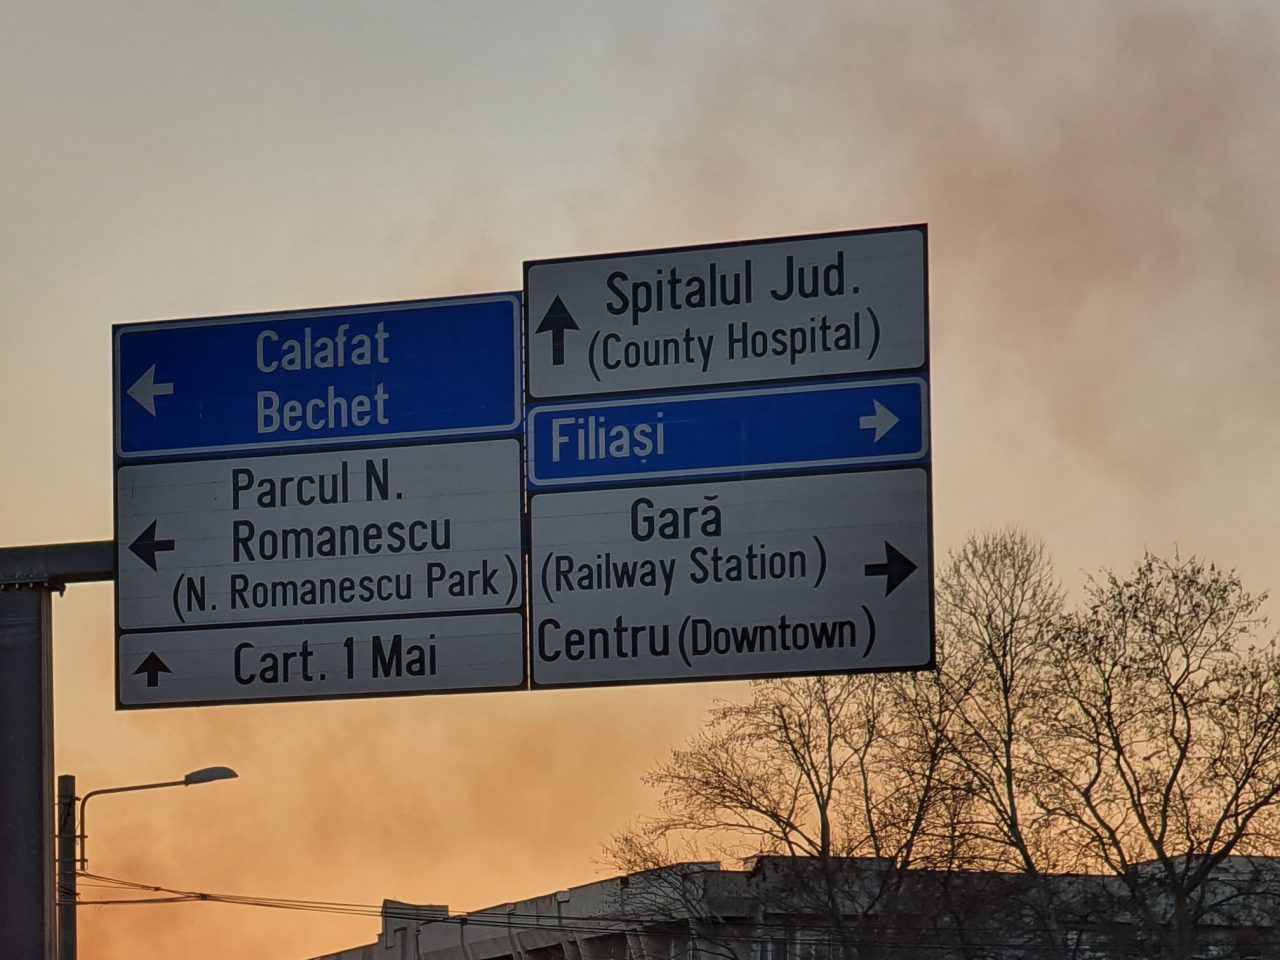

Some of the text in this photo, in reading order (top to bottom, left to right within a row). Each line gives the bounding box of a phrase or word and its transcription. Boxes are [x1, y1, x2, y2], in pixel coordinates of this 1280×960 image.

[605, 250, 862, 325] Spitalul Jud.
[255, 322, 390, 374] Calafat
[588, 308, 882, 381] (County Hospital)
[256, 383, 390, 434] Bechet
[550, 412, 666, 464] Filiași
[232, 458, 404, 510] Parcul N.
[232, 518, 453, 564] Romanescu
[629, 494, 722, 542] Gară
[172, 553, 519, 622] (N. Romanescu Park)
[541, 535, 829, 603] (Railway Station)
[232, 634, 438, 685] Cart. 1 Mai
[537, 604, 879, 666] Centru (Downtown)
